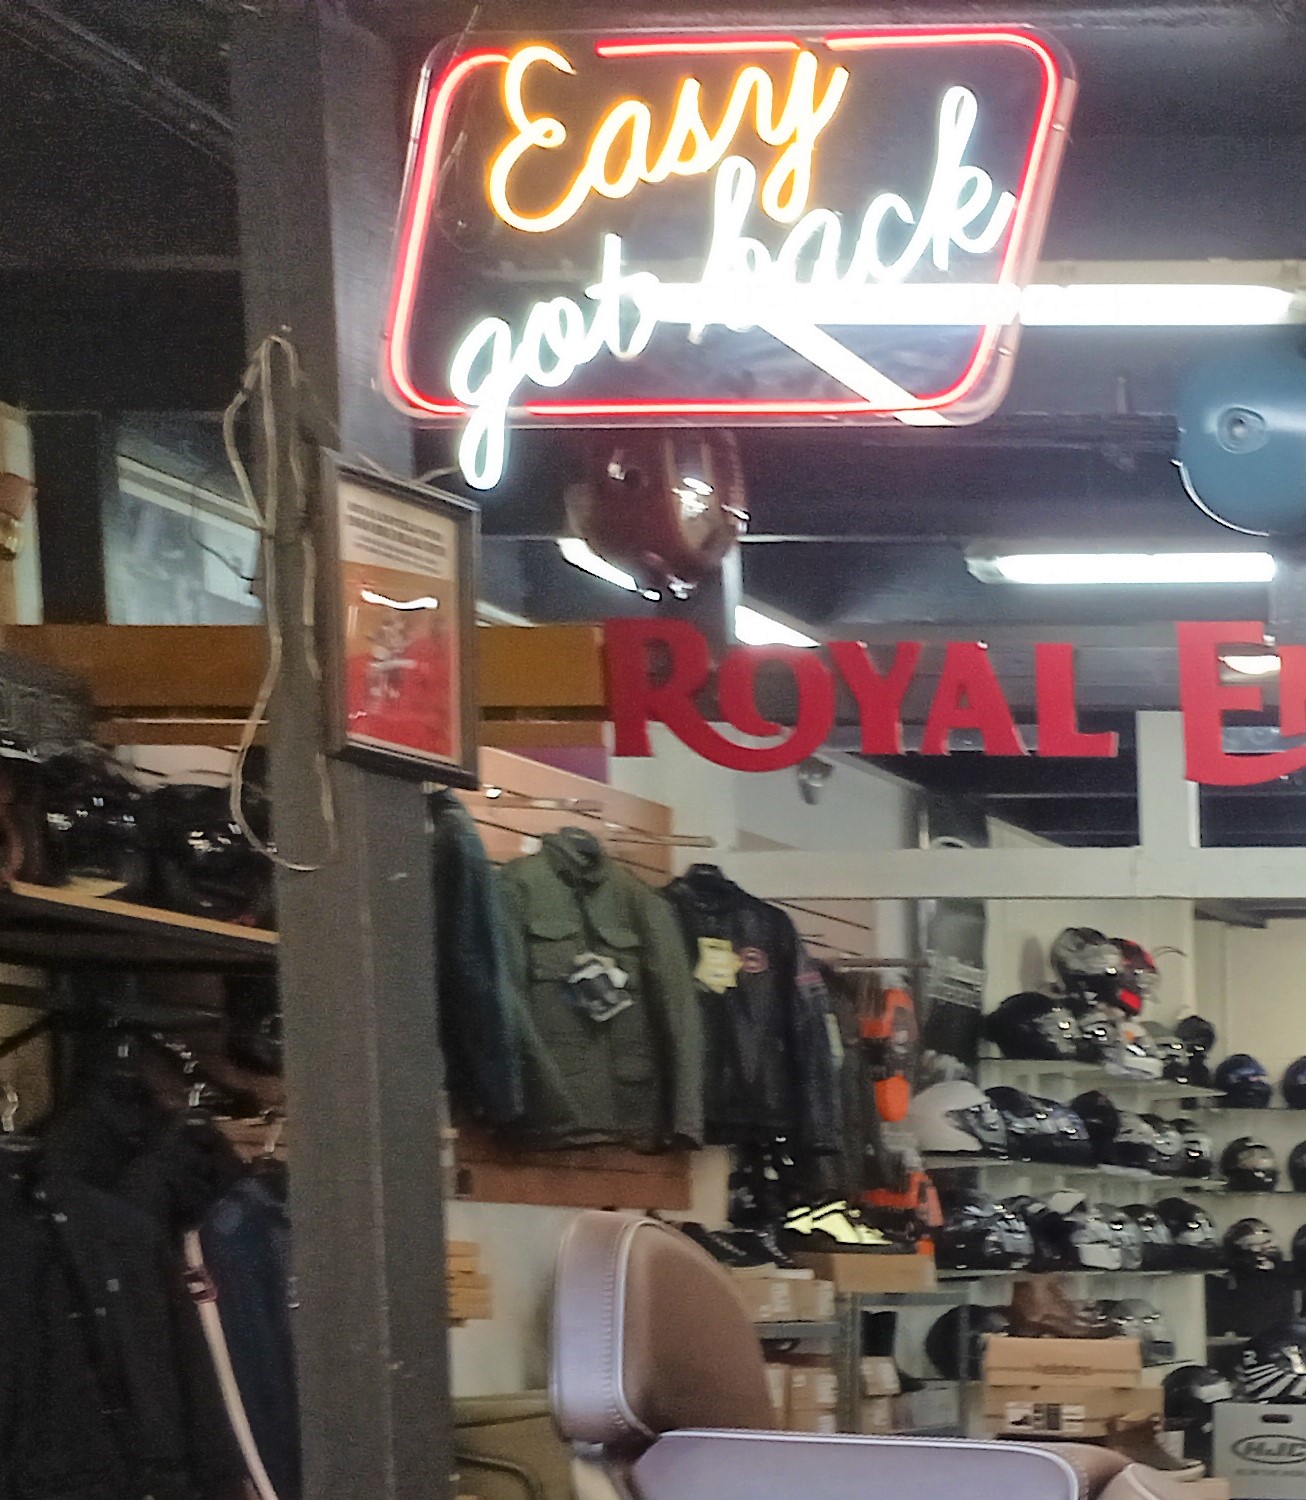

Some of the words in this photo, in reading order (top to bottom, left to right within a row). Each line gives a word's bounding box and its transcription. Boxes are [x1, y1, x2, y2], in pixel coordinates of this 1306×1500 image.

[485, 45, 849, 224] Easy
[448, 234, 662, 491] got
[600, 618, 1118, 773] ROYAL
